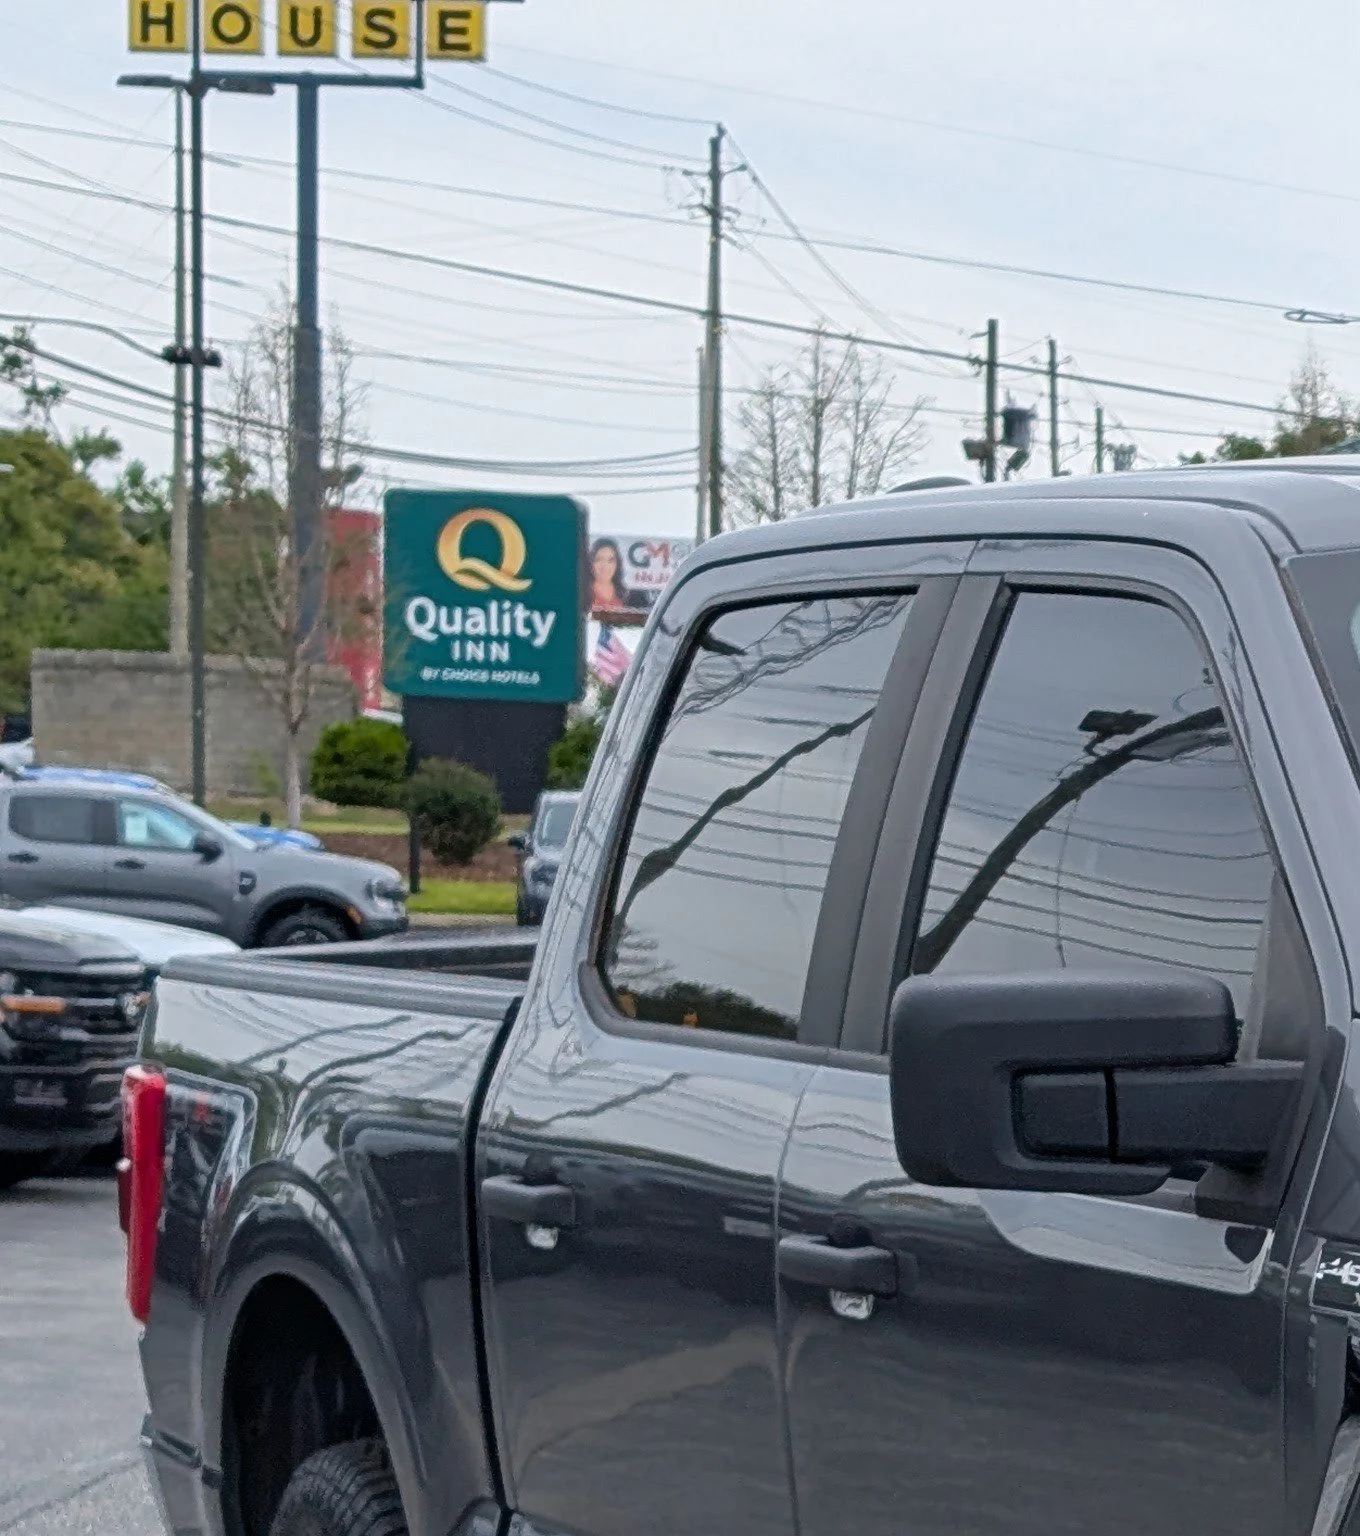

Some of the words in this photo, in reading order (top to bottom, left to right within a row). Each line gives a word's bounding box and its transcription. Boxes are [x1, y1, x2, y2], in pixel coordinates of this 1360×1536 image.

[140, 1, 474, 51] HOUSE
[437, 507, 533, 592] Q
[405, 596, 556, 647] Quality
[451, 640, 511, 663] INN
